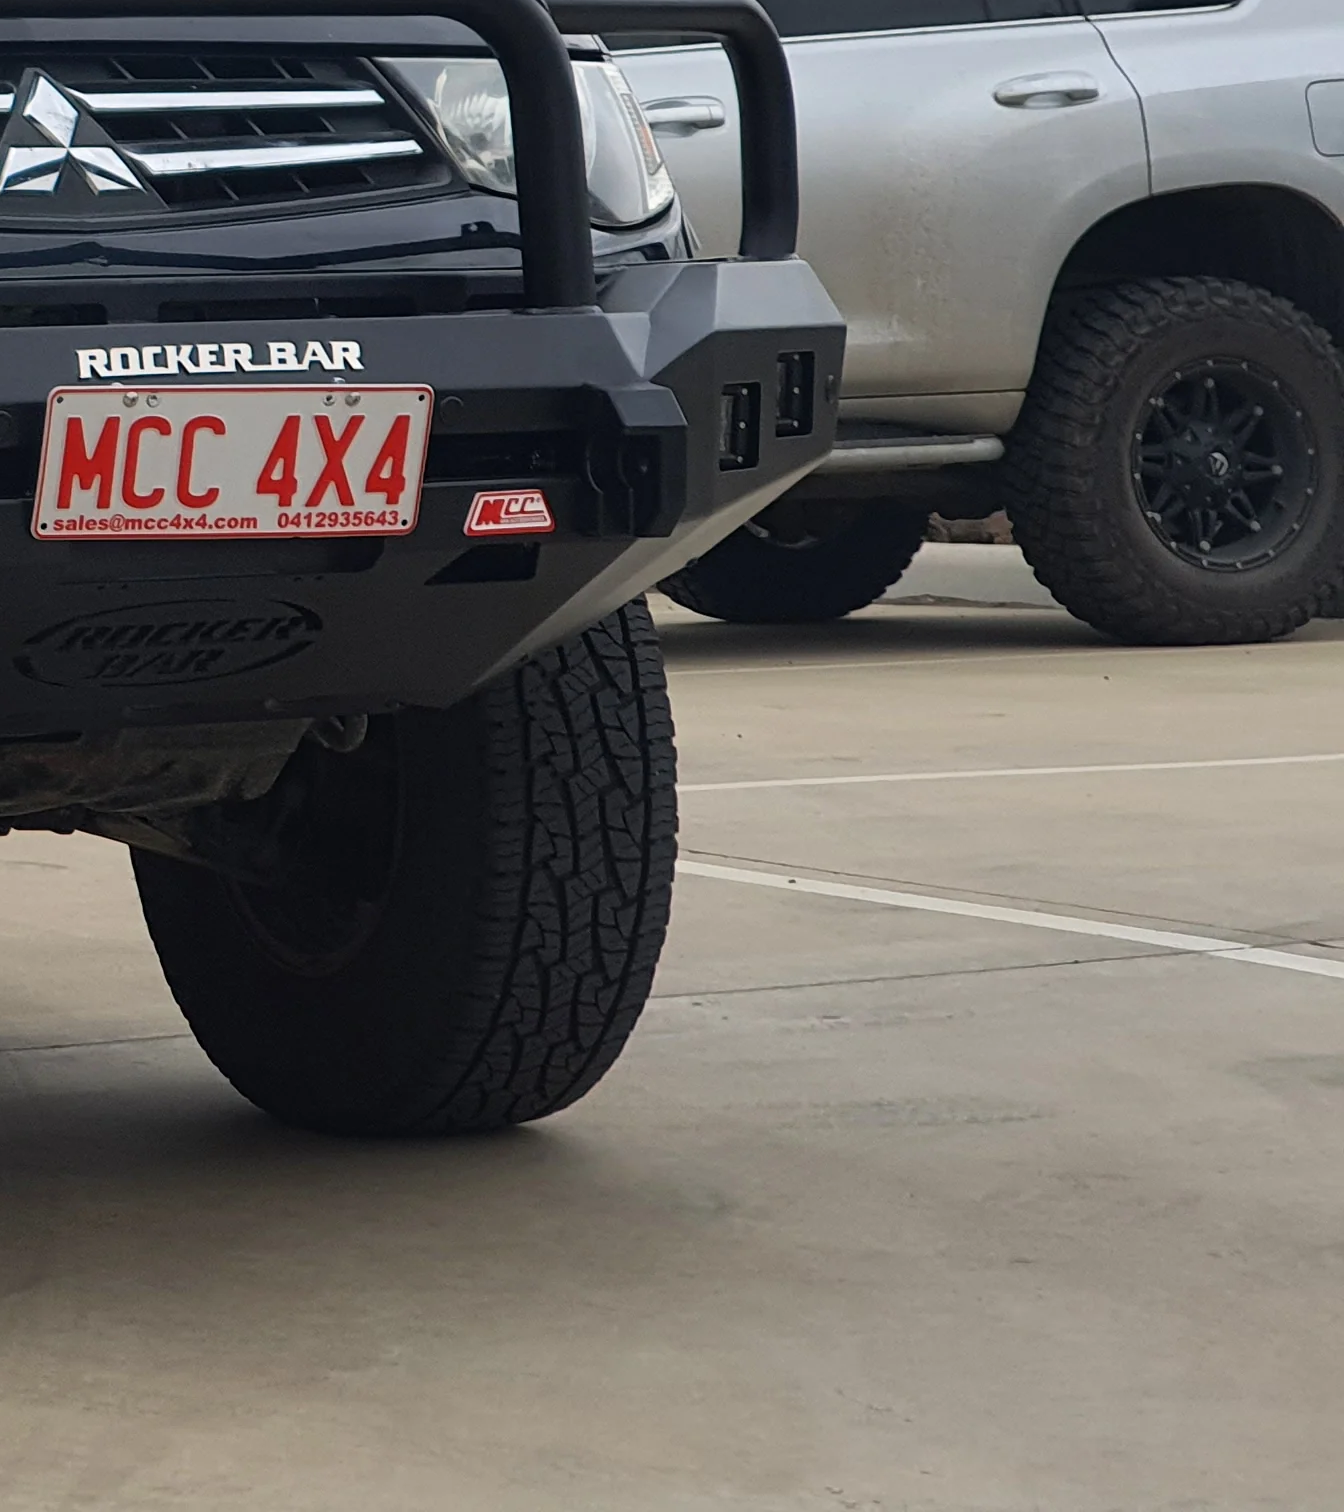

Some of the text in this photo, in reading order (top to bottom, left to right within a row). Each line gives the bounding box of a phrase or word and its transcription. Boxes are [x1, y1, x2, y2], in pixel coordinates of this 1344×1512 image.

[76, 340, 365, 379] ROCKER BAR
[56, 414, 411, 510] MCC 4X4
[52, 510, 399, 531] sales@mcc4x4.com 0412935643
